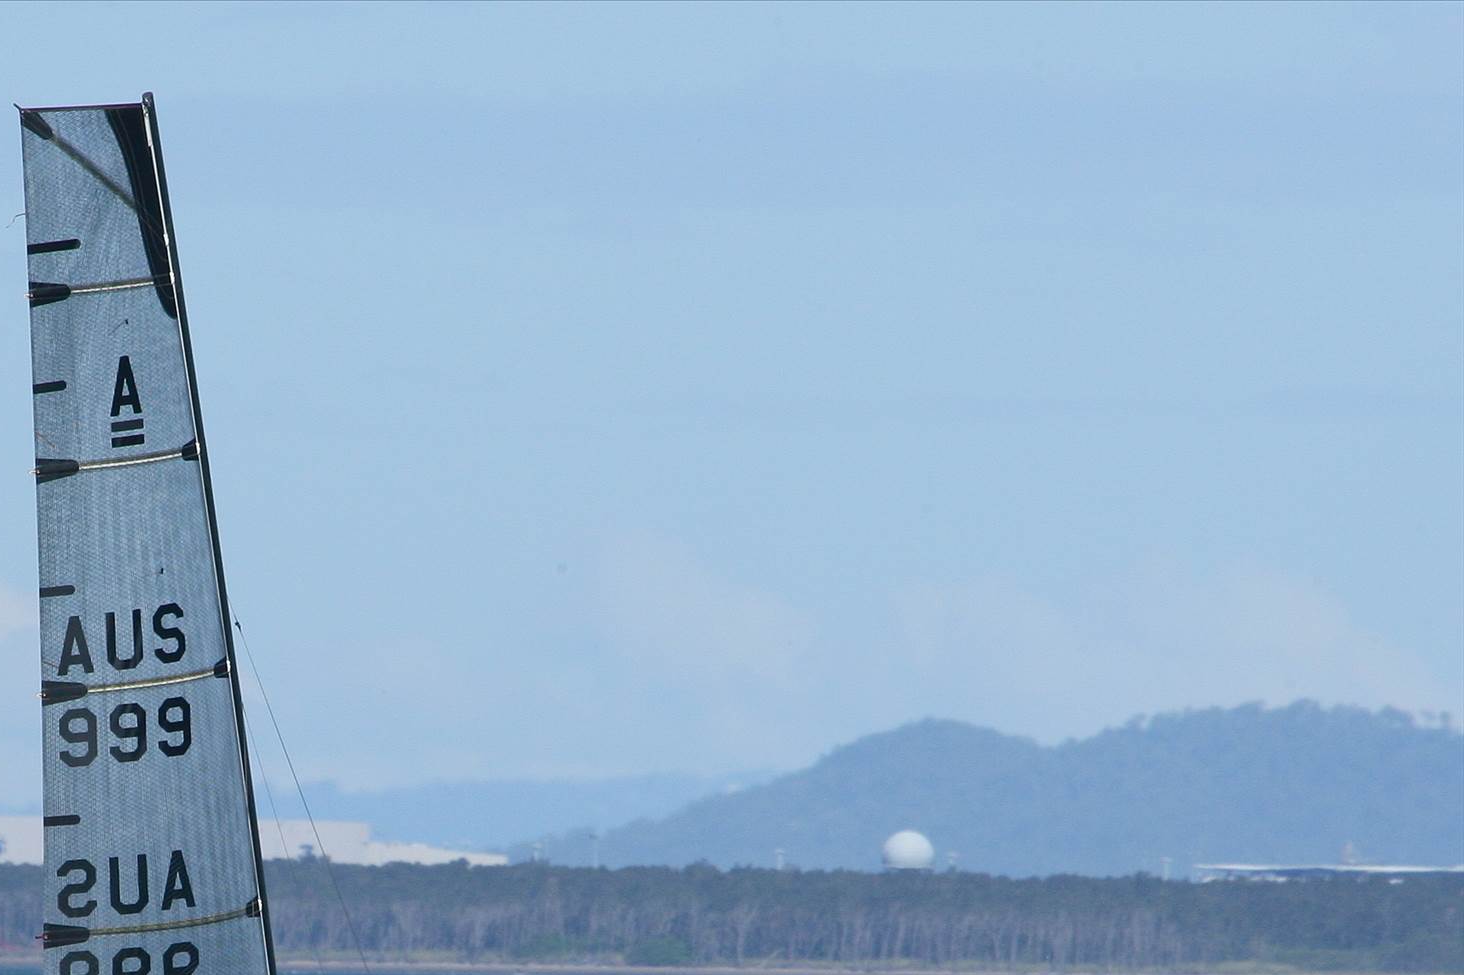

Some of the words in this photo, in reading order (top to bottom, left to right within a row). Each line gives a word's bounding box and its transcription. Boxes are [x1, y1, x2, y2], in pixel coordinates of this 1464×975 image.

[110, 355, 142, 416] A
[58, 602, 186, 675] AUS
[59, 696, 192, 766] 999
